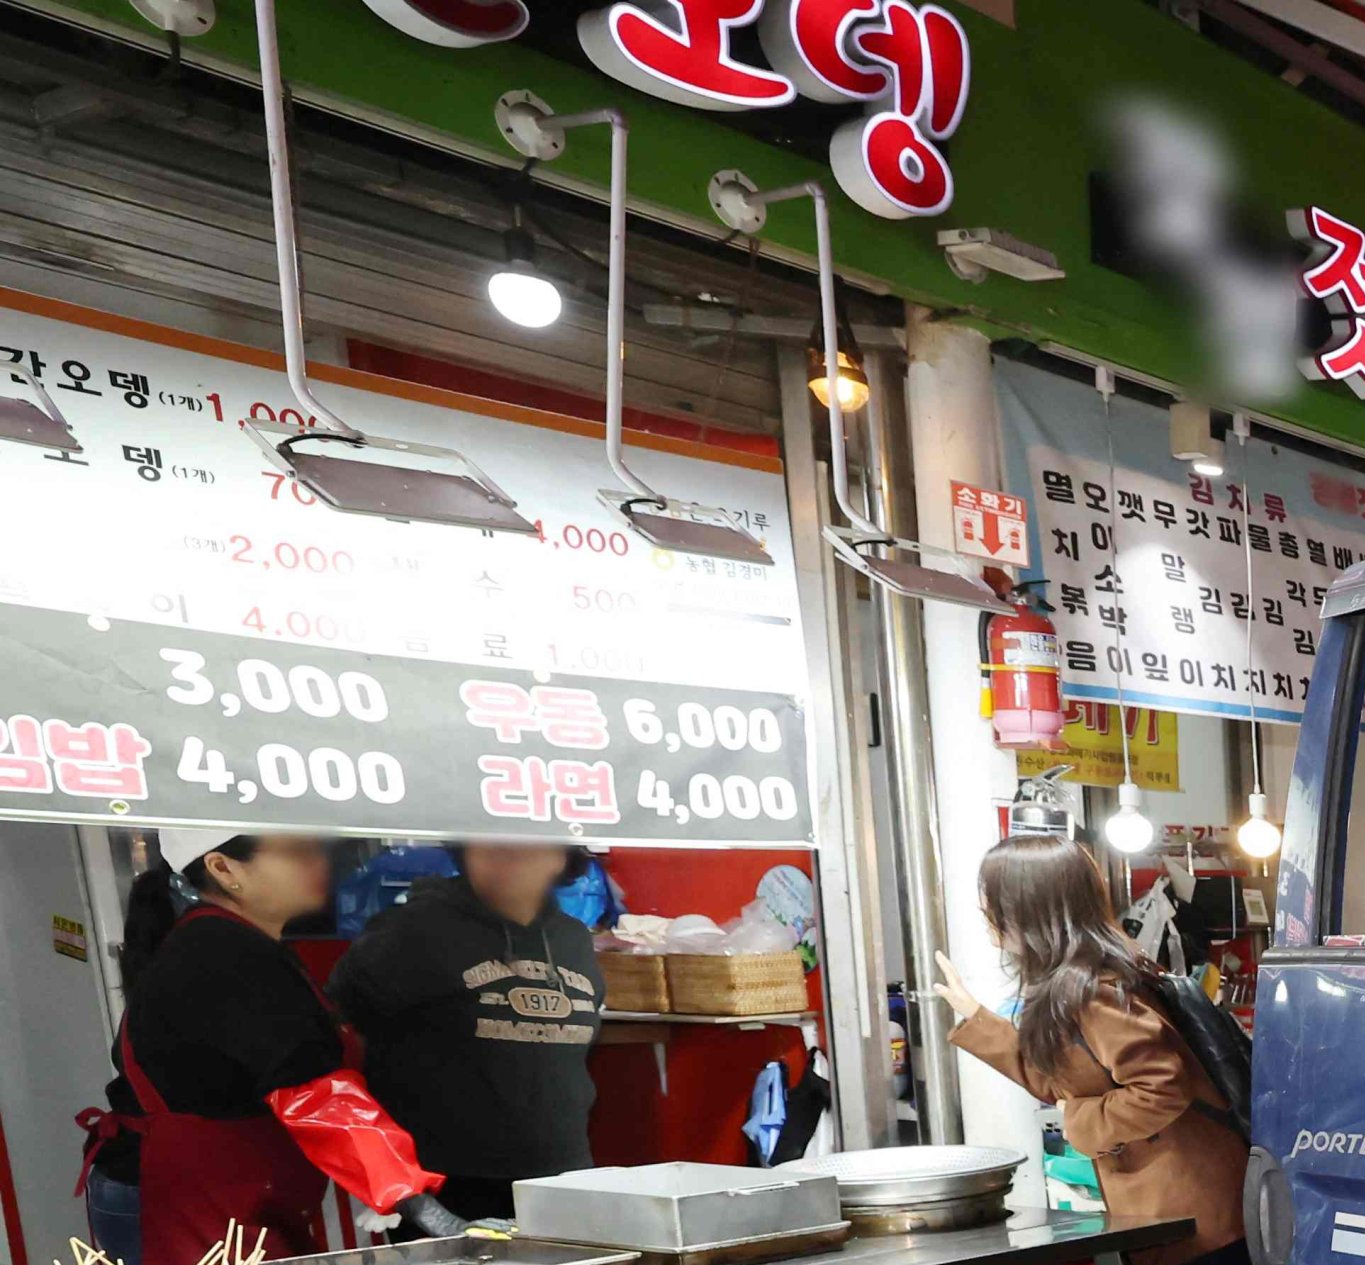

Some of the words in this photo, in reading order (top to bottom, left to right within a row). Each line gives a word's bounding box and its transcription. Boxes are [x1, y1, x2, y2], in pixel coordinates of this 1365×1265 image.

[957, 487, 1023, 515] 소화기
[229, 534, 354, 574] 2,000
[571, 584, 638, 614] 500
[159, 647, 390, 724] 3,000
[459, 680, 610, 751] 우동
[622, 698, 783, 753] 6,000
[176, 736, 407, 804] 4,000
[477, 754, 621, 825] 라면
[637, 769, 798, 825] 4,000
[520, 993, 561, 1012] 1917
